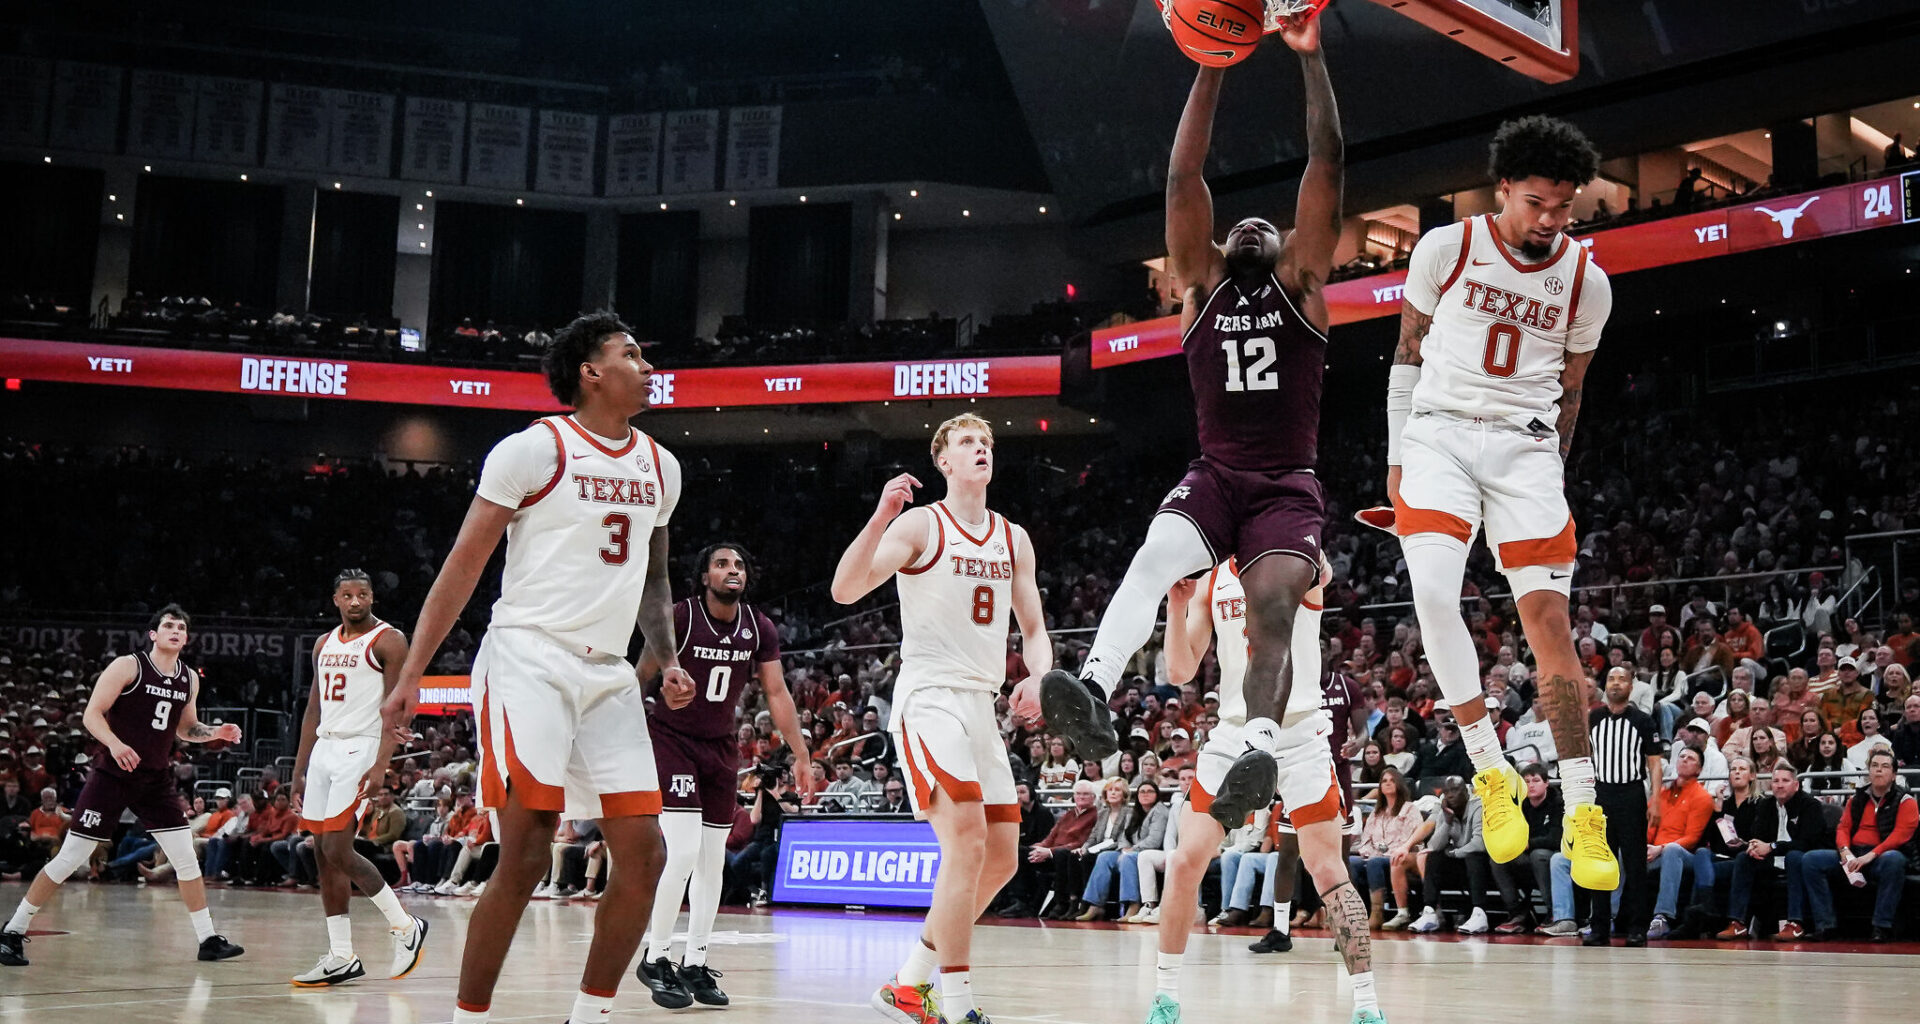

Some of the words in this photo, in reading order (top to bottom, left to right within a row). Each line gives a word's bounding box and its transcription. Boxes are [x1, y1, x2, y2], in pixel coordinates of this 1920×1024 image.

[1197, 10, 1246, 37] ELITE
[1864, 185, 1893, 219] 24
[1463, 278, 1564, 332] TEXAS
[1108, 335, 1138, 353] YETI
[1481, 319, 1524, 379] 0
[87, 356, 132, 373] YETI
[240, 357, 348, 396] DEFENSE
[894, 362, 990, 396] DEFENSE
[1221, 336, 1279, 392] 12
[449, 380, 491, 396] YETI
[764, 377, 802, 392] YETI
[572, 473, 656, 507] TEXAS
[599, 511, 632, 567] 3
[950, 554, 1012, 580] TEXAS
[971, 584, 994, 626] 8
[320, 653, 359, 668] TEXAS
[693, 645, 730, 661] TEXAS
[145, 684, 172, 698] TEXAS
[323, 672, 347, 701] 12
[706, 665, 732, 702] 0
[151, 700, 172, 731] 9
[790, 849, 850, 881] BUD
[851, 850, 939, 883] LIGHT
